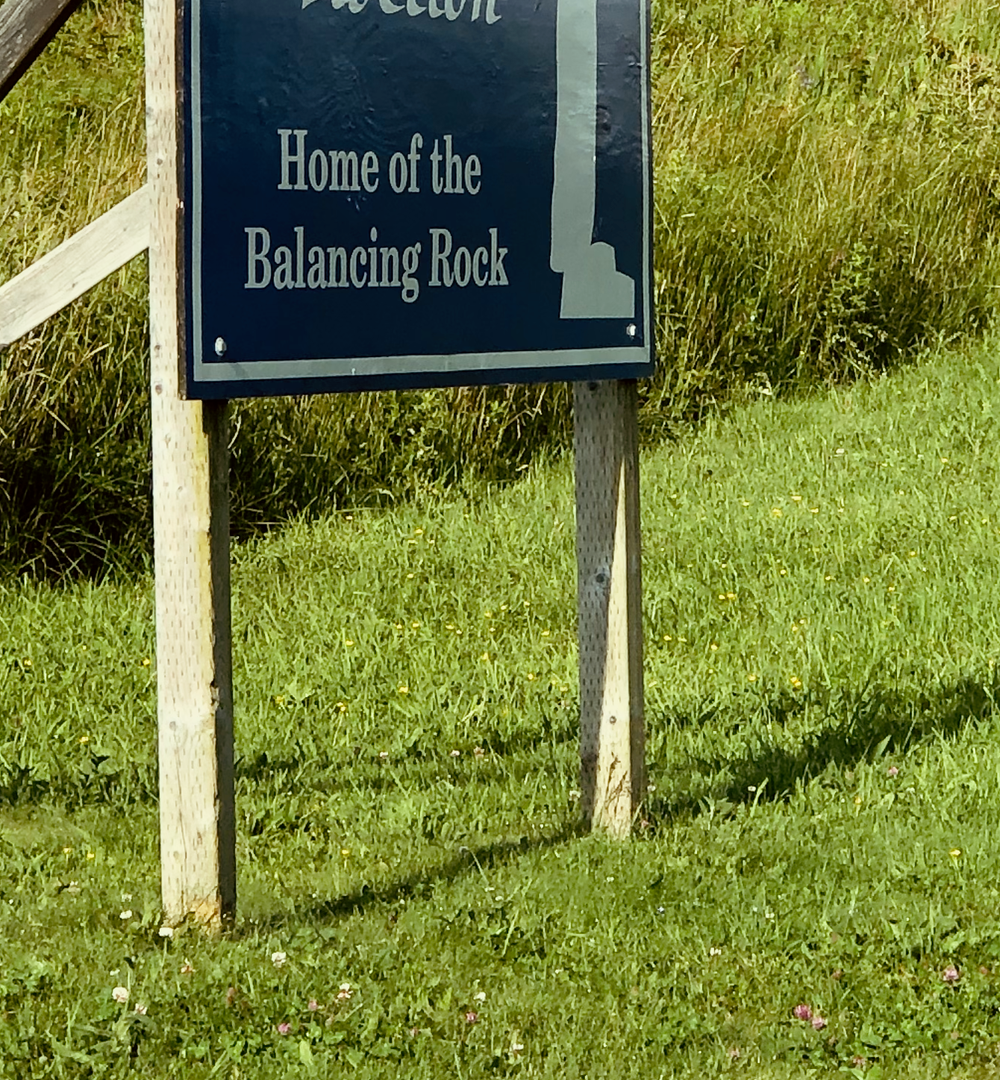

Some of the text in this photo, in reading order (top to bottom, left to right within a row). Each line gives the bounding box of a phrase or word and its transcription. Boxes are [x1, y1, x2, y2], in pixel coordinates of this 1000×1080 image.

[277, 128, 482, 195] Home of the
[244, 226, 509, 304] Balancing Rock
